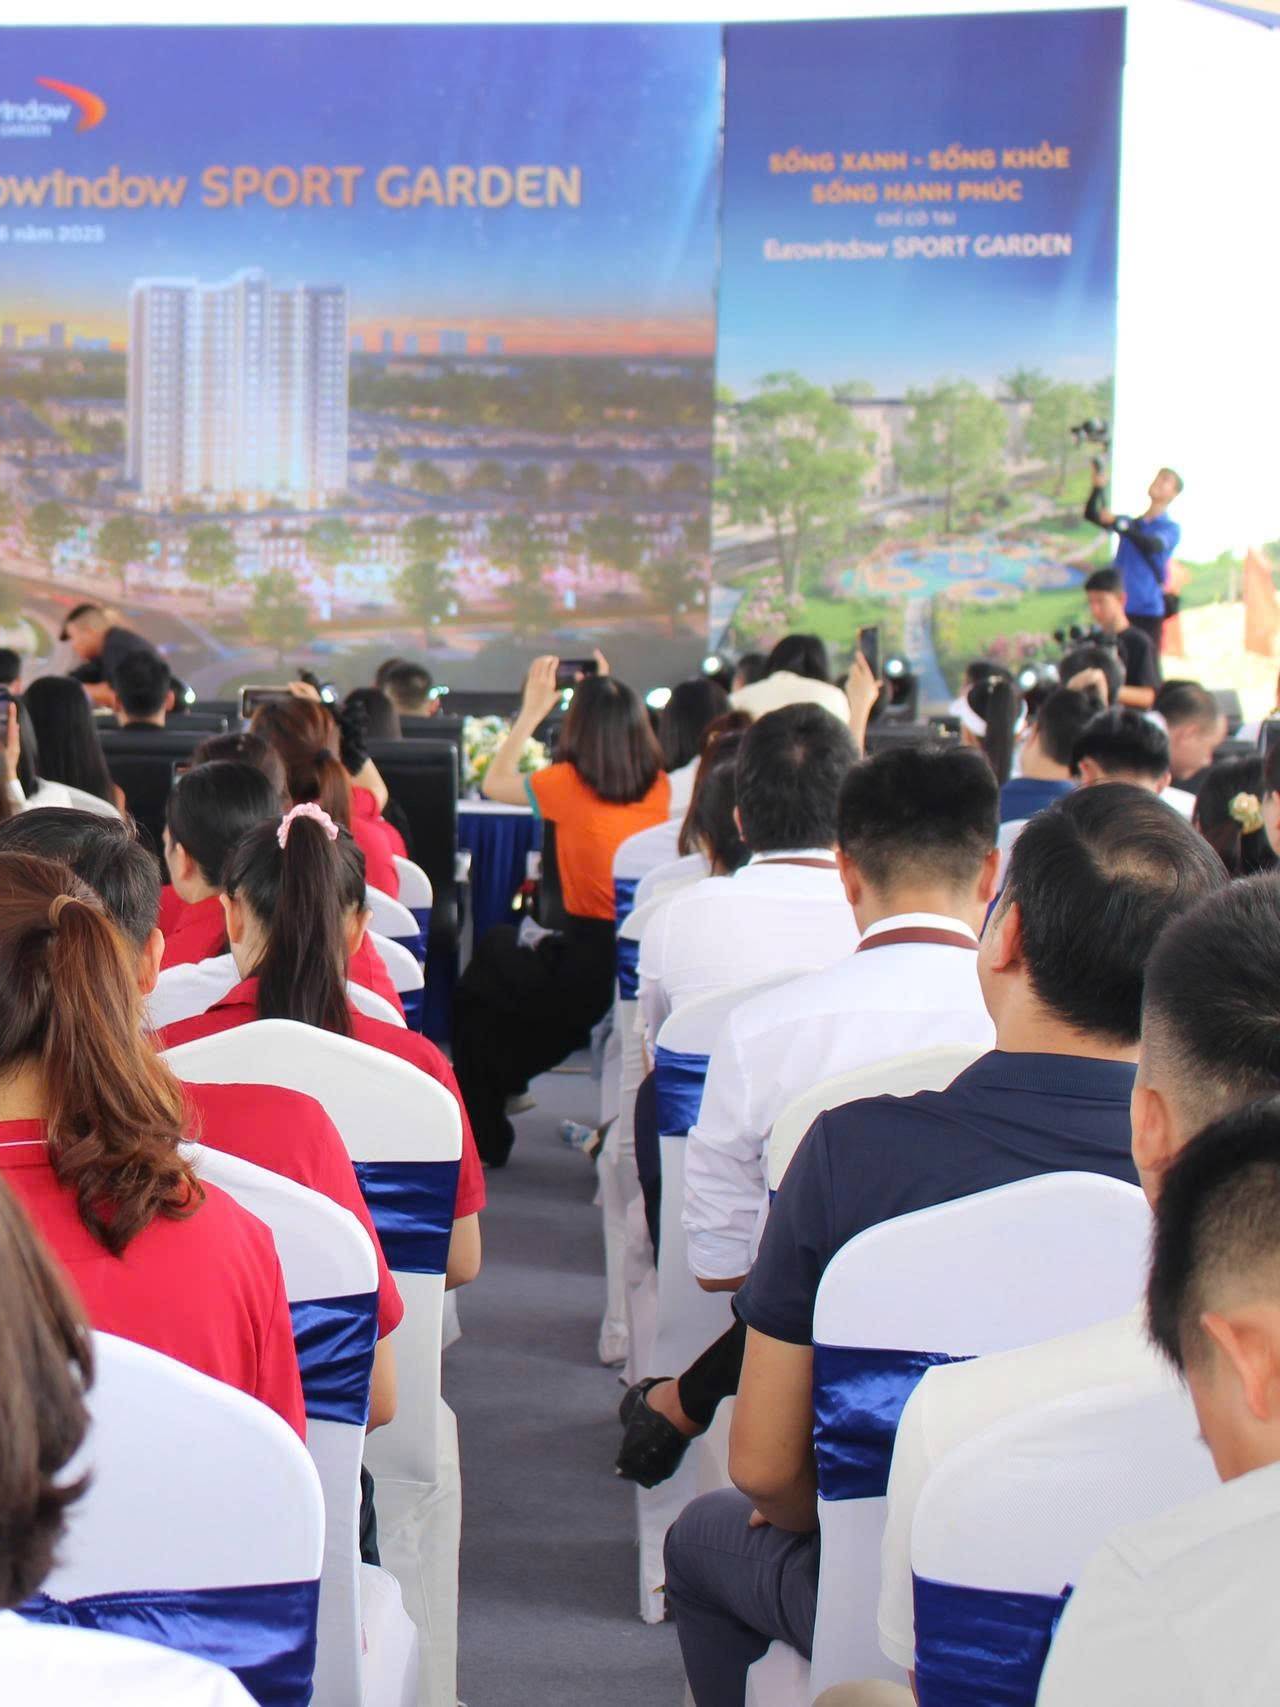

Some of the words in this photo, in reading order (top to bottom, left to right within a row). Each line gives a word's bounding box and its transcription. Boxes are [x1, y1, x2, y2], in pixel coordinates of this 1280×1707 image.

[200, 165, 364, 208] SPORT
[375, 165, 582, 208] GARDEN
[892, 234, 970, 259] SPORT
[972, 232, 1072, 257] GARDEN
